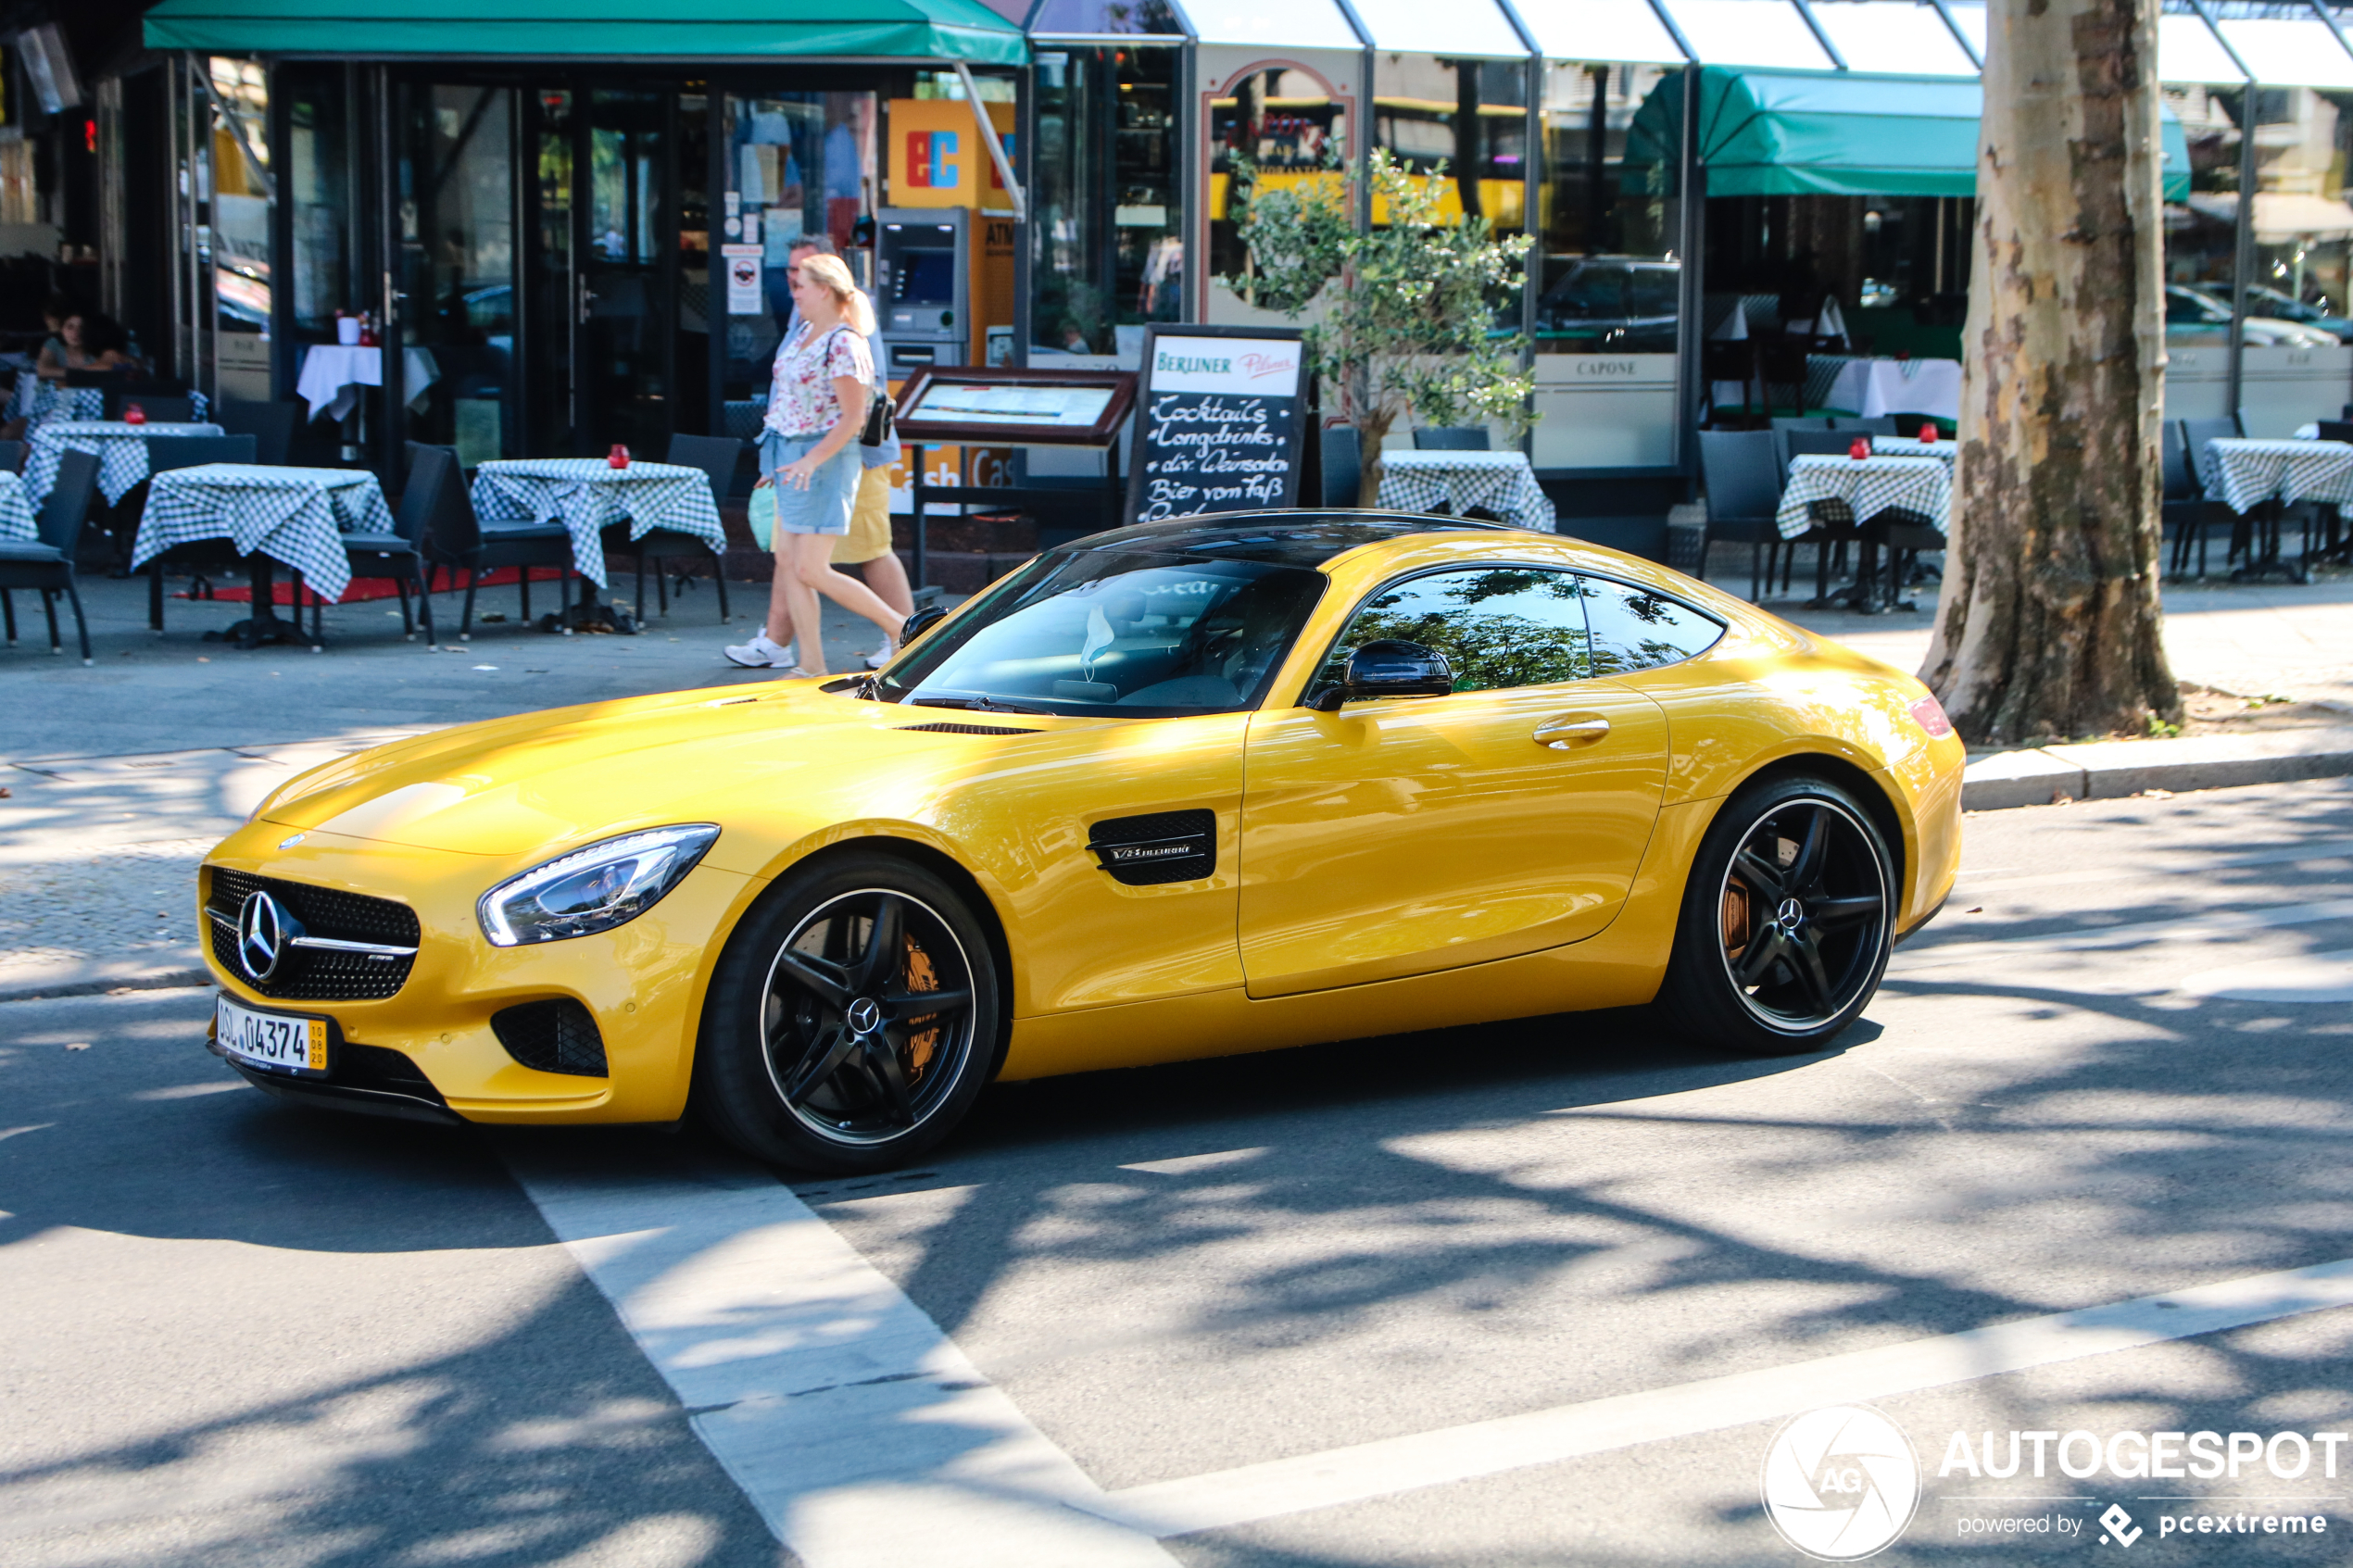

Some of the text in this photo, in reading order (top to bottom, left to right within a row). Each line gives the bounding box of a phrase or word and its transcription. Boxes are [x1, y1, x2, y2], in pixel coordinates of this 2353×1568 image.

[1158, 352, 1232, 374] BERLINER
[1577, 361, 1637, 375] CAPONE
[1154, 395, 1267, 423] Cocktails
[1147, 474, 1283, 505] Bier vom Faß
[245, 1015, 305, 1062] 04374
[311, 1025, 322, 1037] 10
[311, 1039, 322, 1050] 08
[311, 1052, 322, 1064] 20
